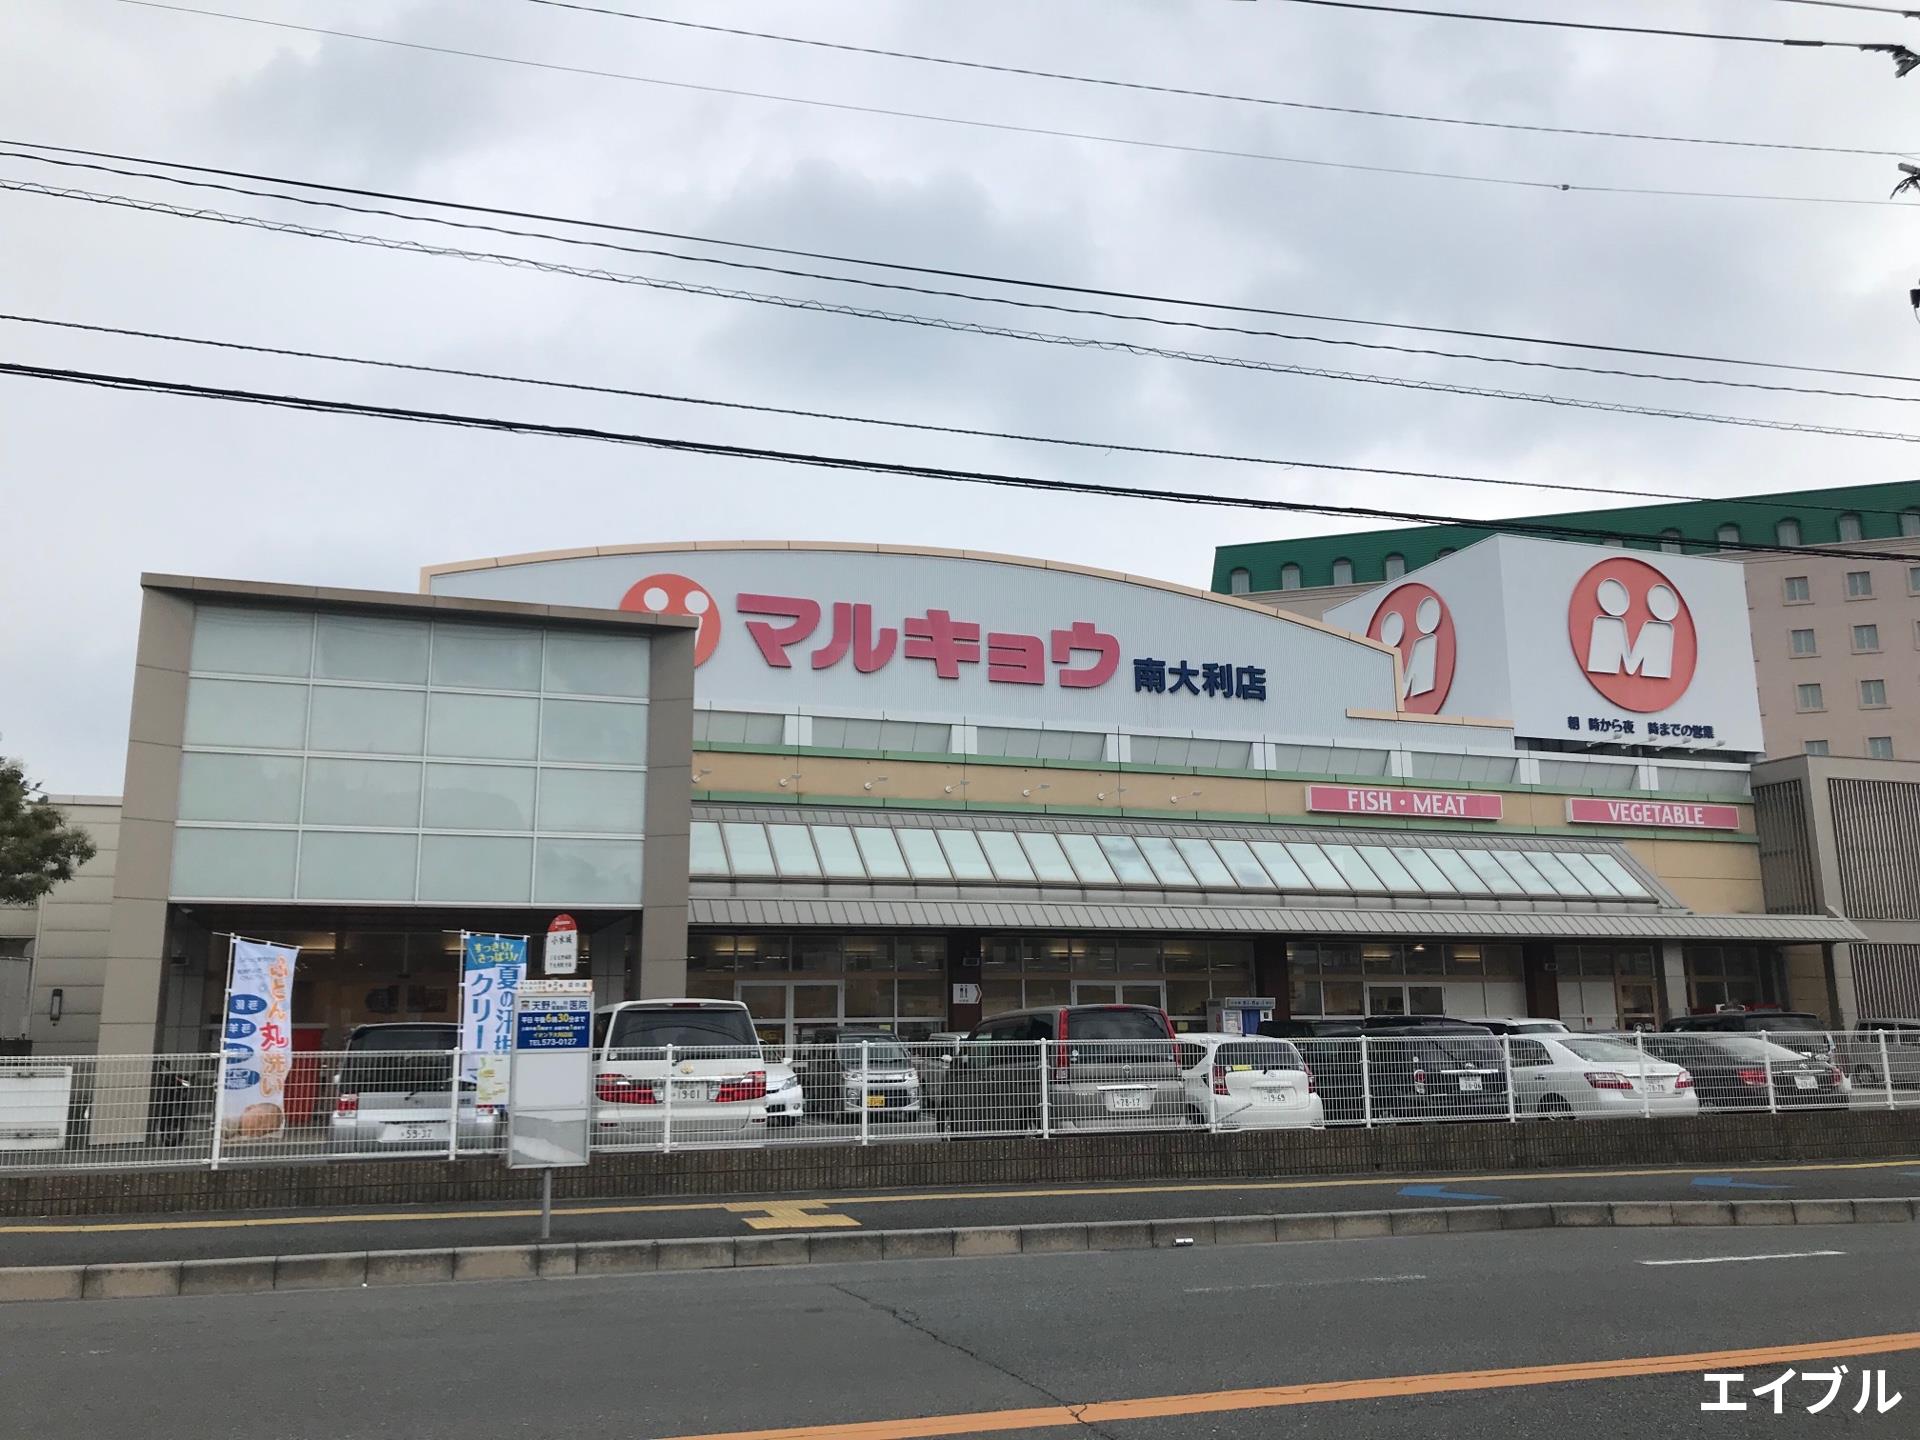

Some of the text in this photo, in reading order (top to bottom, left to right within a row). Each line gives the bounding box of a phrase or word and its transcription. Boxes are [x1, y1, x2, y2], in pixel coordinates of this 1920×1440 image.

[736, 592, 1268, 701] マルキョウ 南大利店
[1347, 790, 1393, 812] FISH
[1412, 793, 1467, 816] MEAT
[1607, 802, 1705, 825] VEGETABLE
